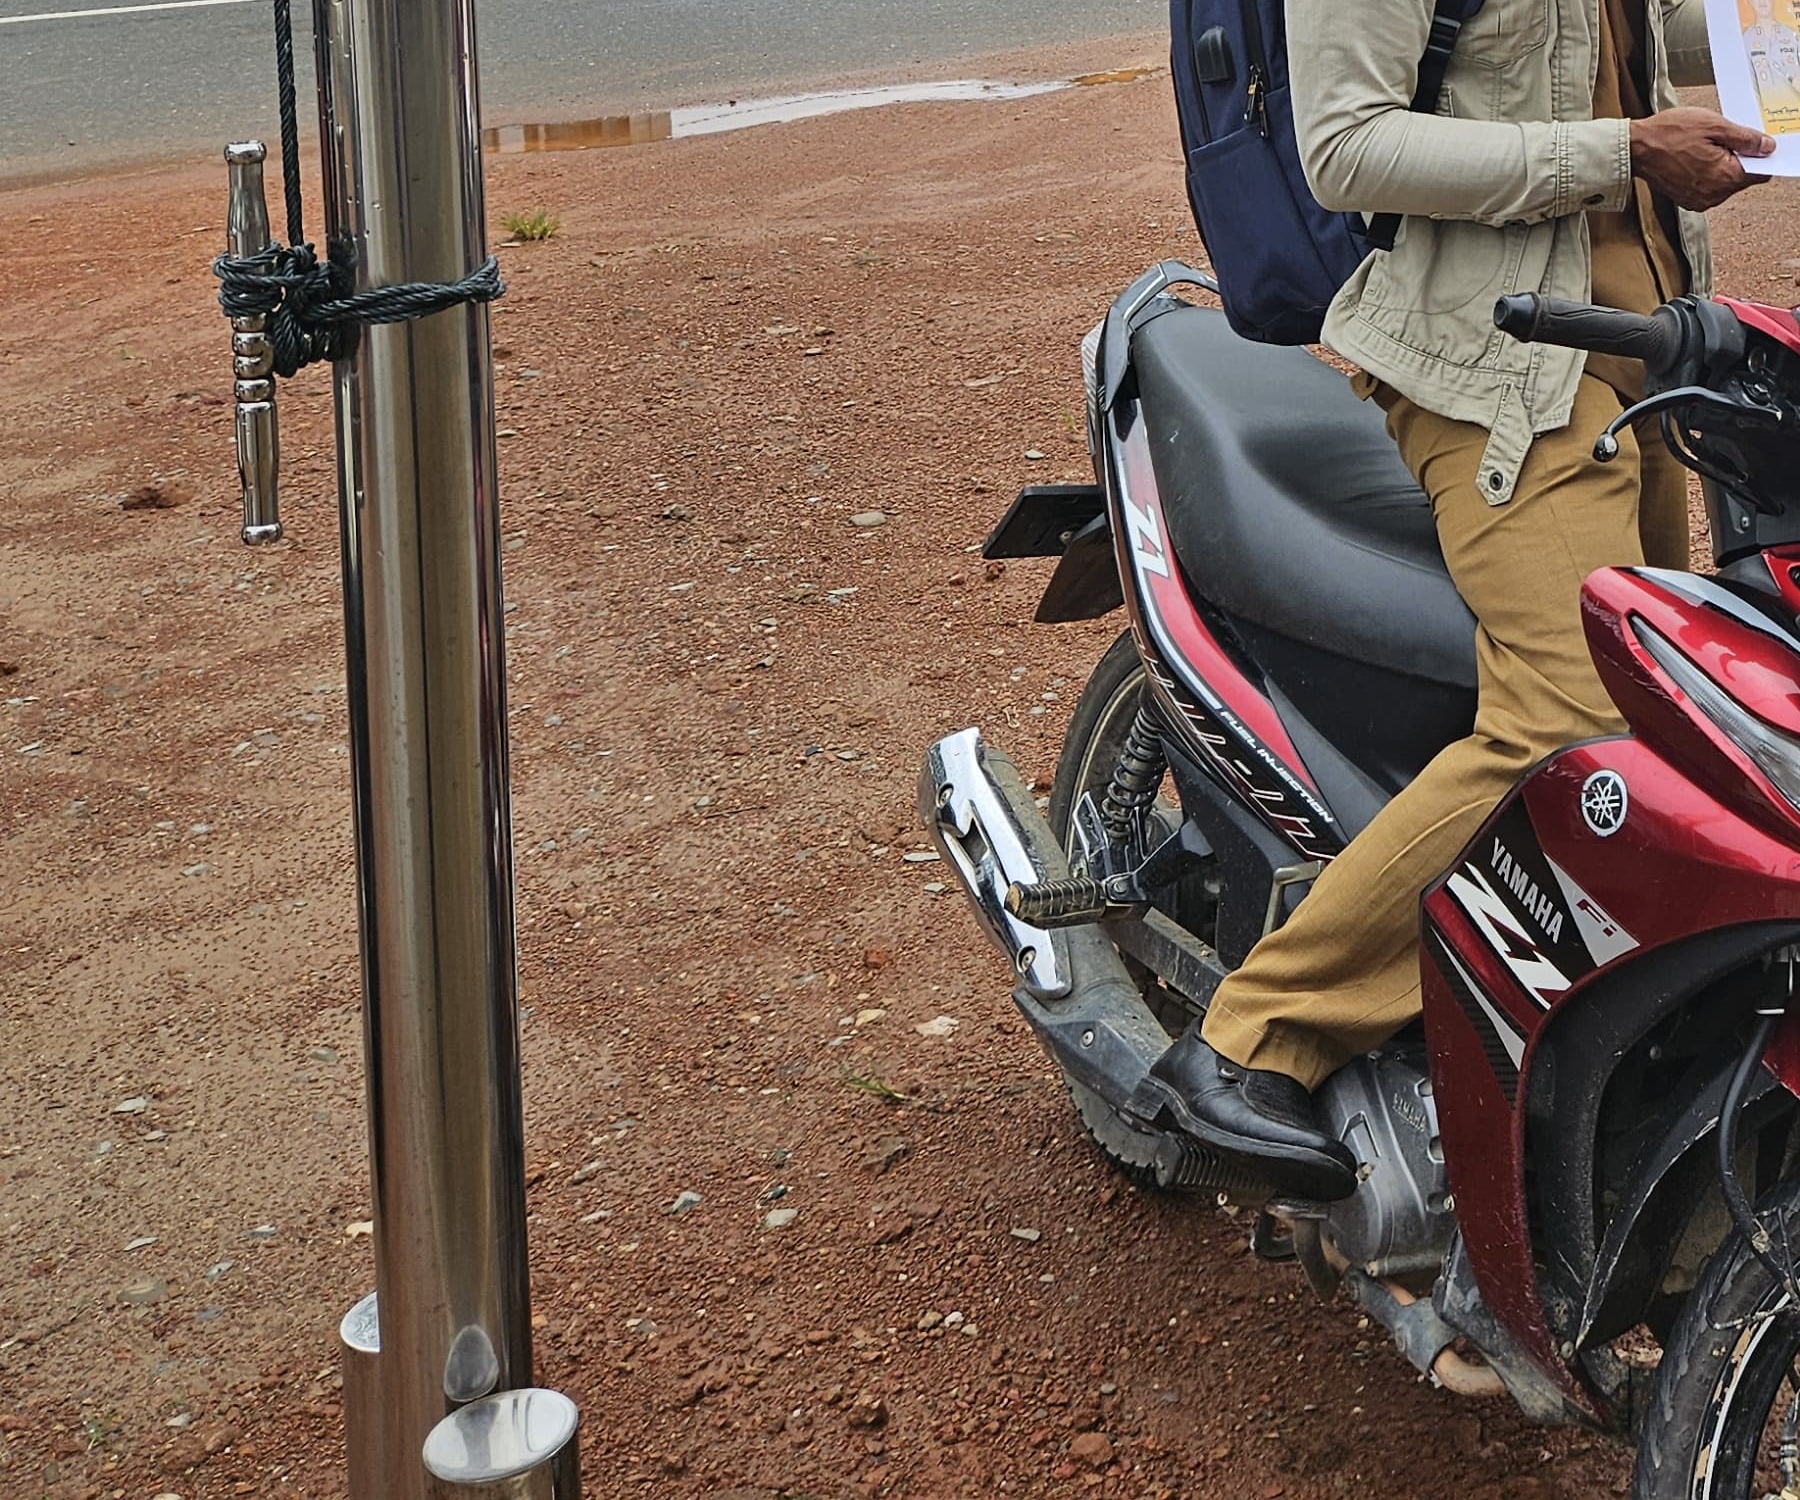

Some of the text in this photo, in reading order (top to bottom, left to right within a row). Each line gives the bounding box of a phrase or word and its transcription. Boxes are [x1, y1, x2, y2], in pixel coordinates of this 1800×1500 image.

[1220, 710, 1257, 749] FUEL
[1257, 748, 1334, 823] INJECTION
[1489, 836, 1565, 944] YAMAHA
